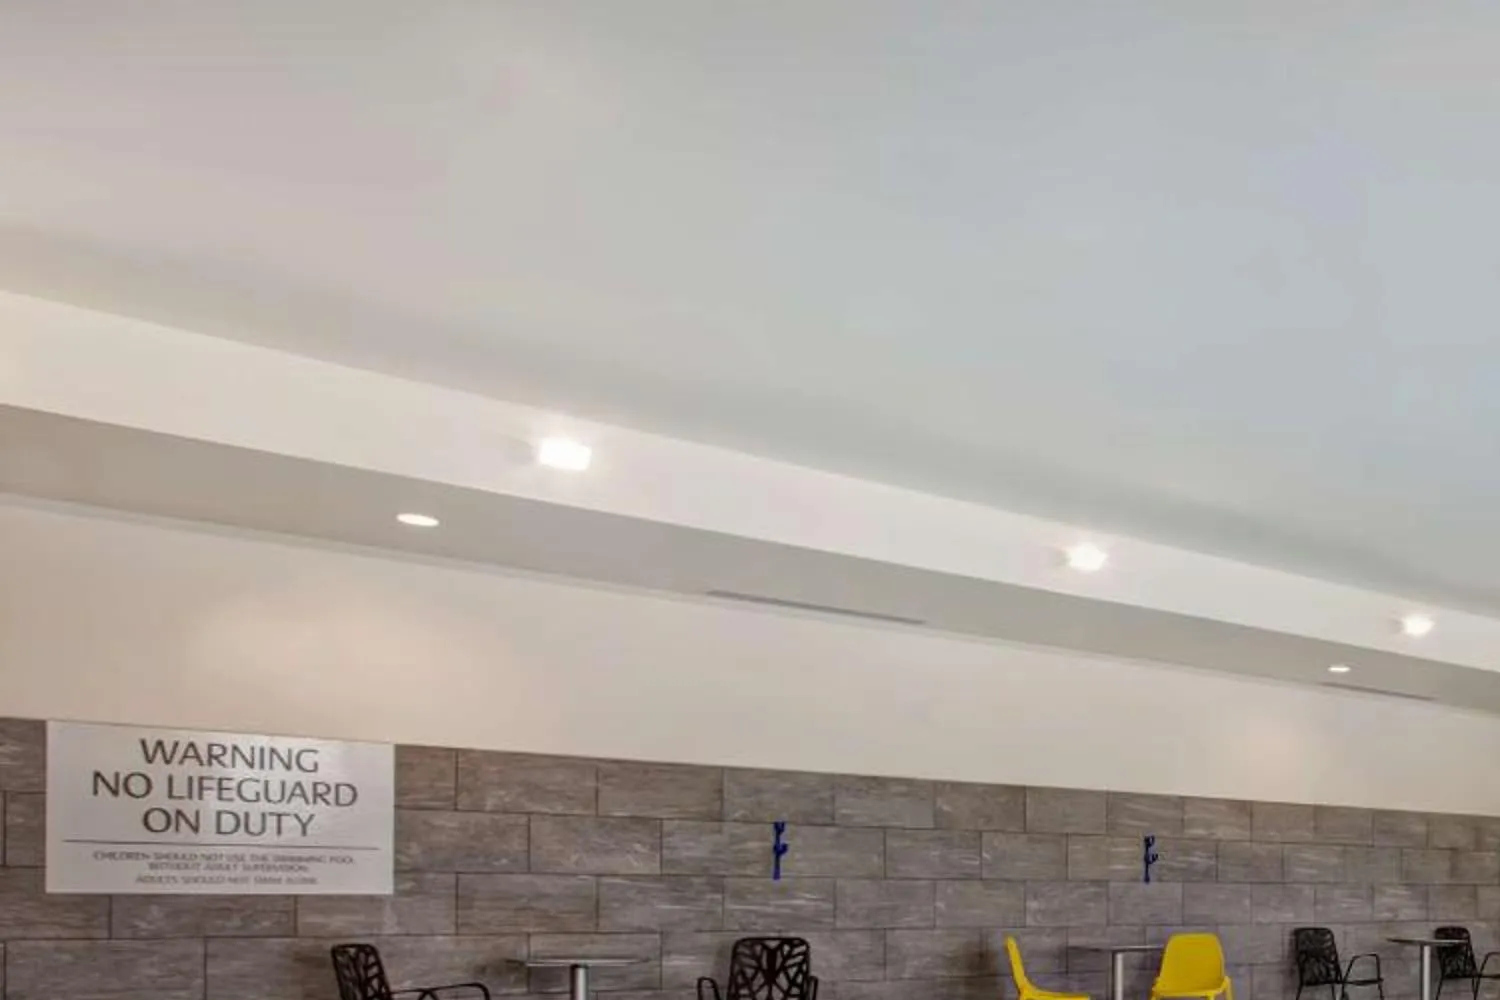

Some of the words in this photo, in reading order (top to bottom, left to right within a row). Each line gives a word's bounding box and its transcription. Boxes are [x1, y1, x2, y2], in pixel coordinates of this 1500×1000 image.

[140, 738, 319, 773] WARNING
[93, 769, 153, 799] NO
[167, 773, 358, 807] LIFEGUARD
[143, 807, 200, 835] ON
[215, 809, 315, 837] DUTY
